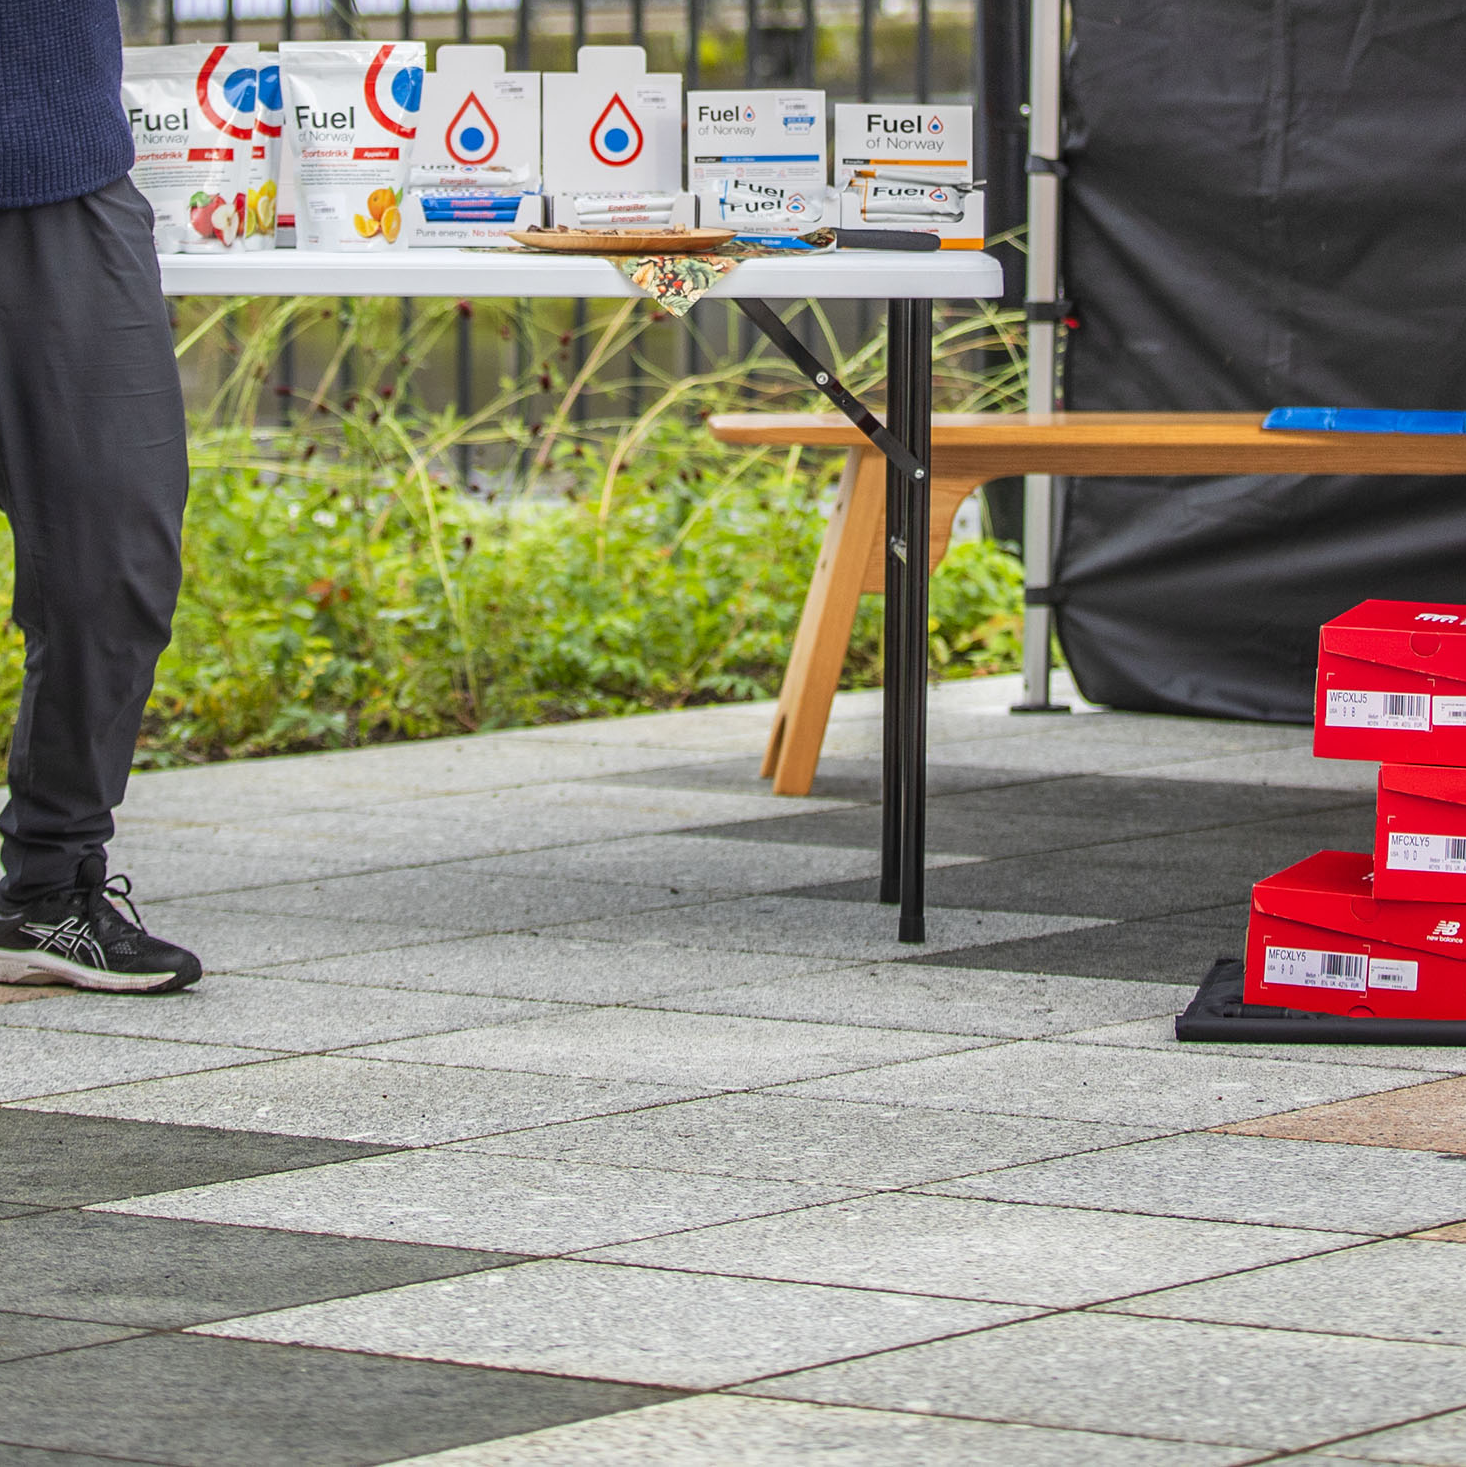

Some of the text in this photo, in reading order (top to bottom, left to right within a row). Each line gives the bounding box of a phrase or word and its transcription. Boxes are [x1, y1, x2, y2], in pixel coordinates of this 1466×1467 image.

[128, 108, 188, 131] Fuel
[295, 106, 354, 129] Fuel
[699, 106, 739, 122] Fuel
[867, 114, 921, 133] Fuel
[298, 131, 354, 144] of Norway
[698, 126, 756, 137] of Norway
[143, 134, 189, 145] Norway
[866, 137, 944, 153] of Norway
[135, 152, 182, 162] portsdrikk
[301, 150, 348, 158] Sportsdrikk
[734, 180, 784, 198] Fuel
[873, 187, 925, 196] Fuel
[608, 204, 648, 212] EnergiBar
[731, 200, 781, 213] Fuel
[416, 229, 436, 237] Pure
[438, 230, 470, 238] energy.
[1330, 692, 1368, 704] WFCXLJ5
[1391, 835, 1430, 847] MFCXLY5
[1439, 935, 1463, 944] balance
[1268, 949, 1306, 962] MFCXLY5
